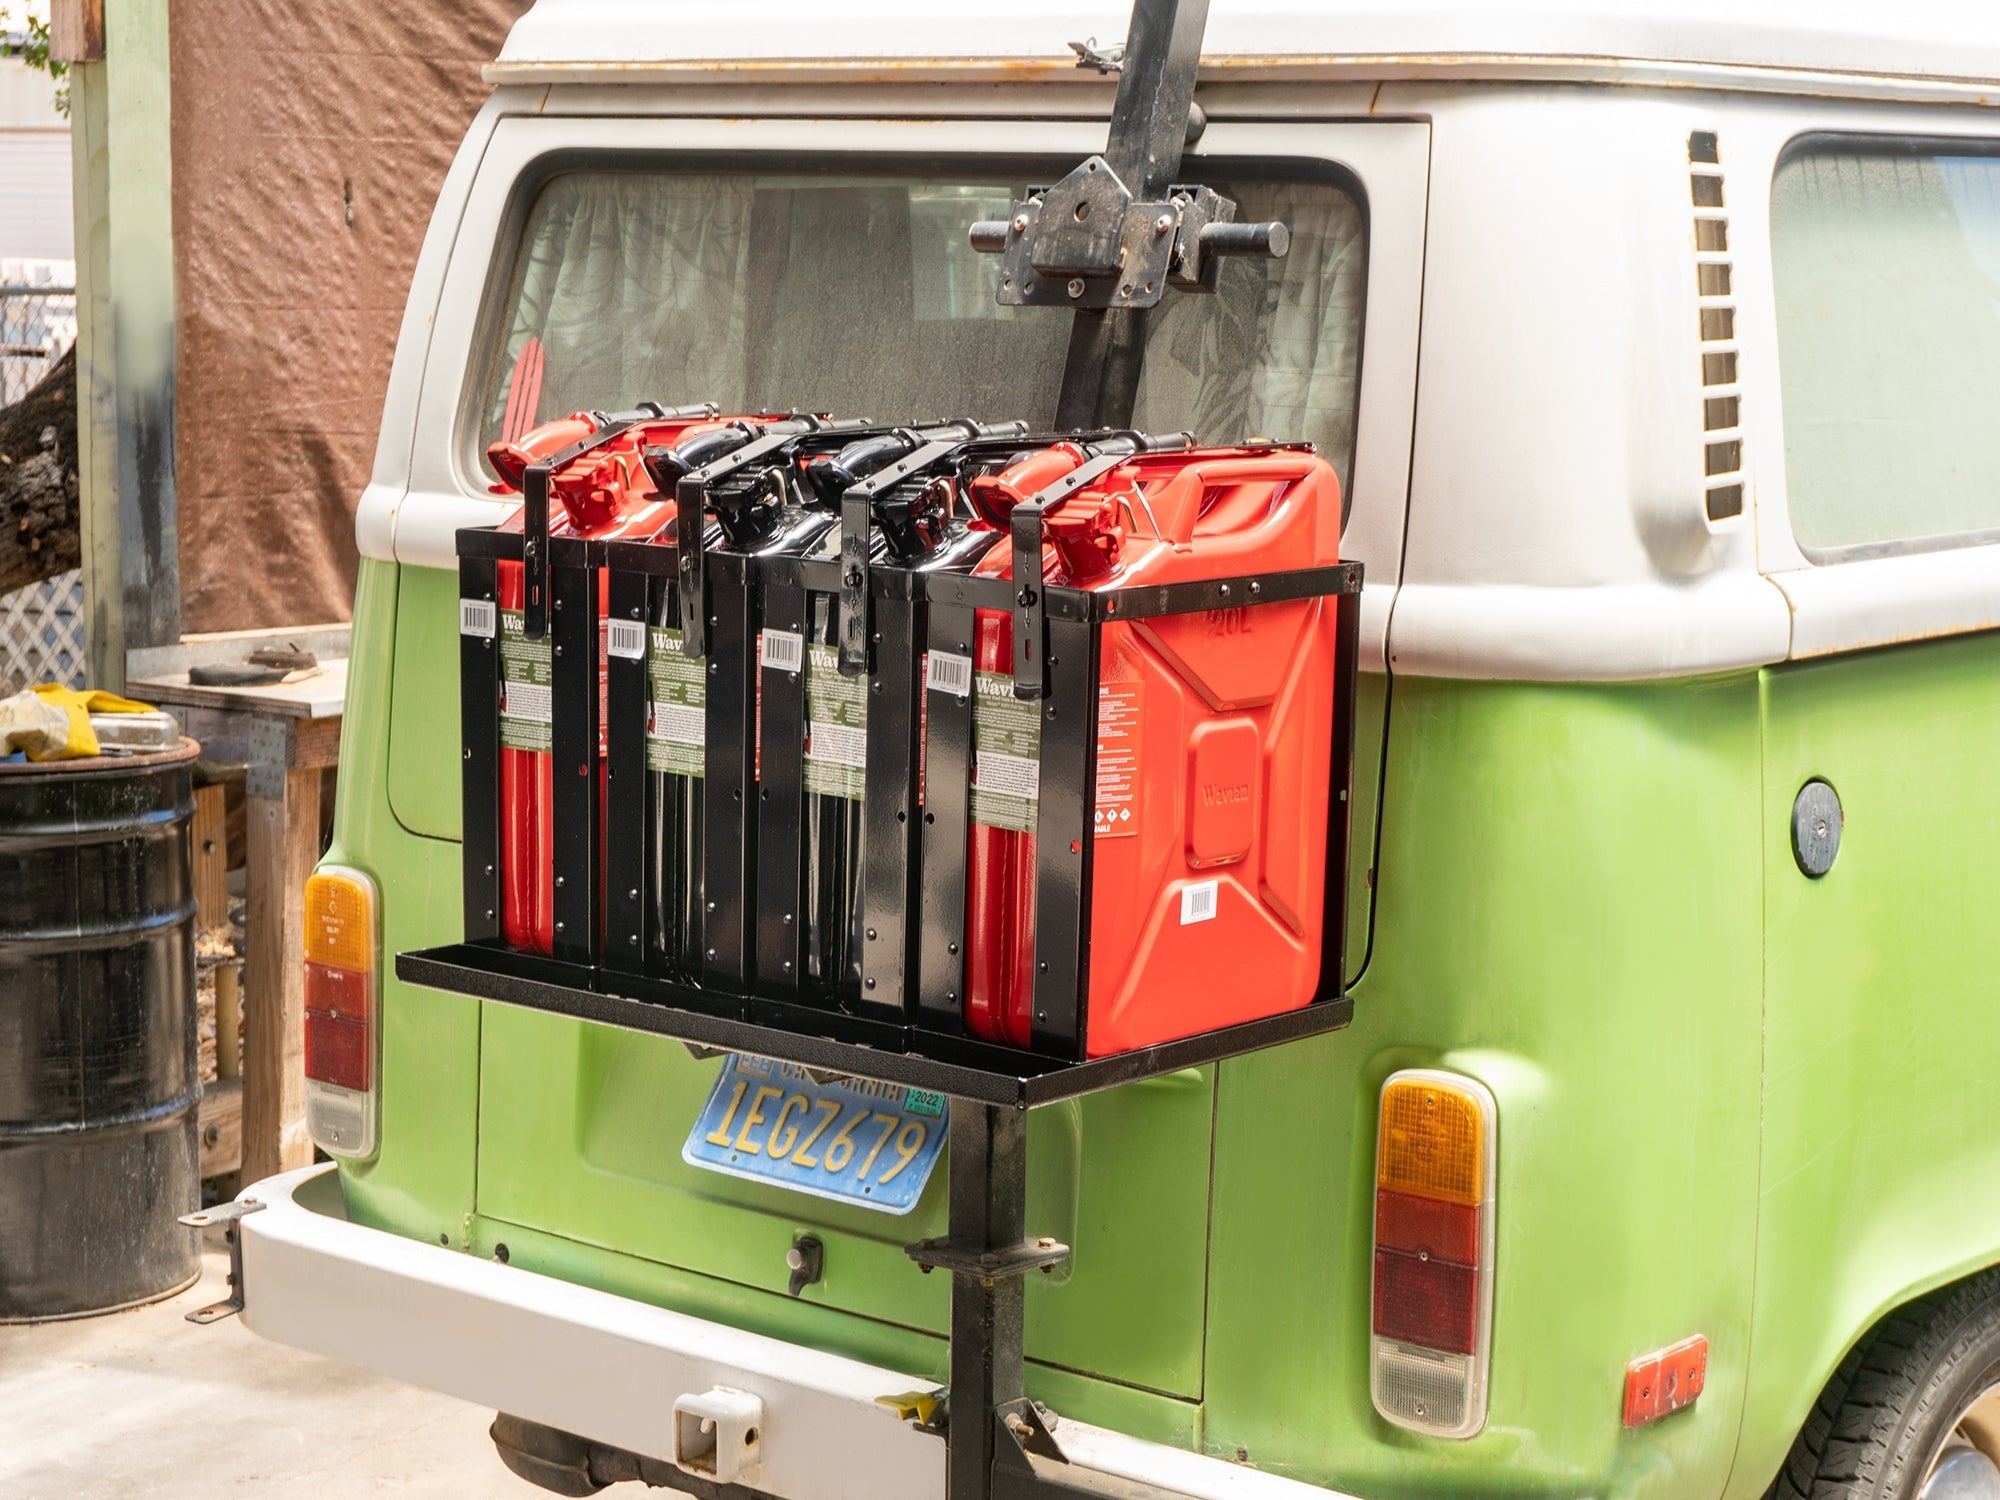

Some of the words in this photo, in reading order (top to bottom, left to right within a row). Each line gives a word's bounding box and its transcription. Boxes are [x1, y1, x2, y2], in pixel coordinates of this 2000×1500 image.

[1206, 606, 1252, 639] 20L
[652, 632, 684, 651] Wav
[809, 650, 838, 668] Wav
[975, 677, 1015, 698] Wavi
[1202, 784, 1249, 807] Wavian
[780, 1061, 900, 1102] CAORNIA
[914, 1090, 939, 1106] 2022
[705, 1080, 927, 1185] 1EGZ679
